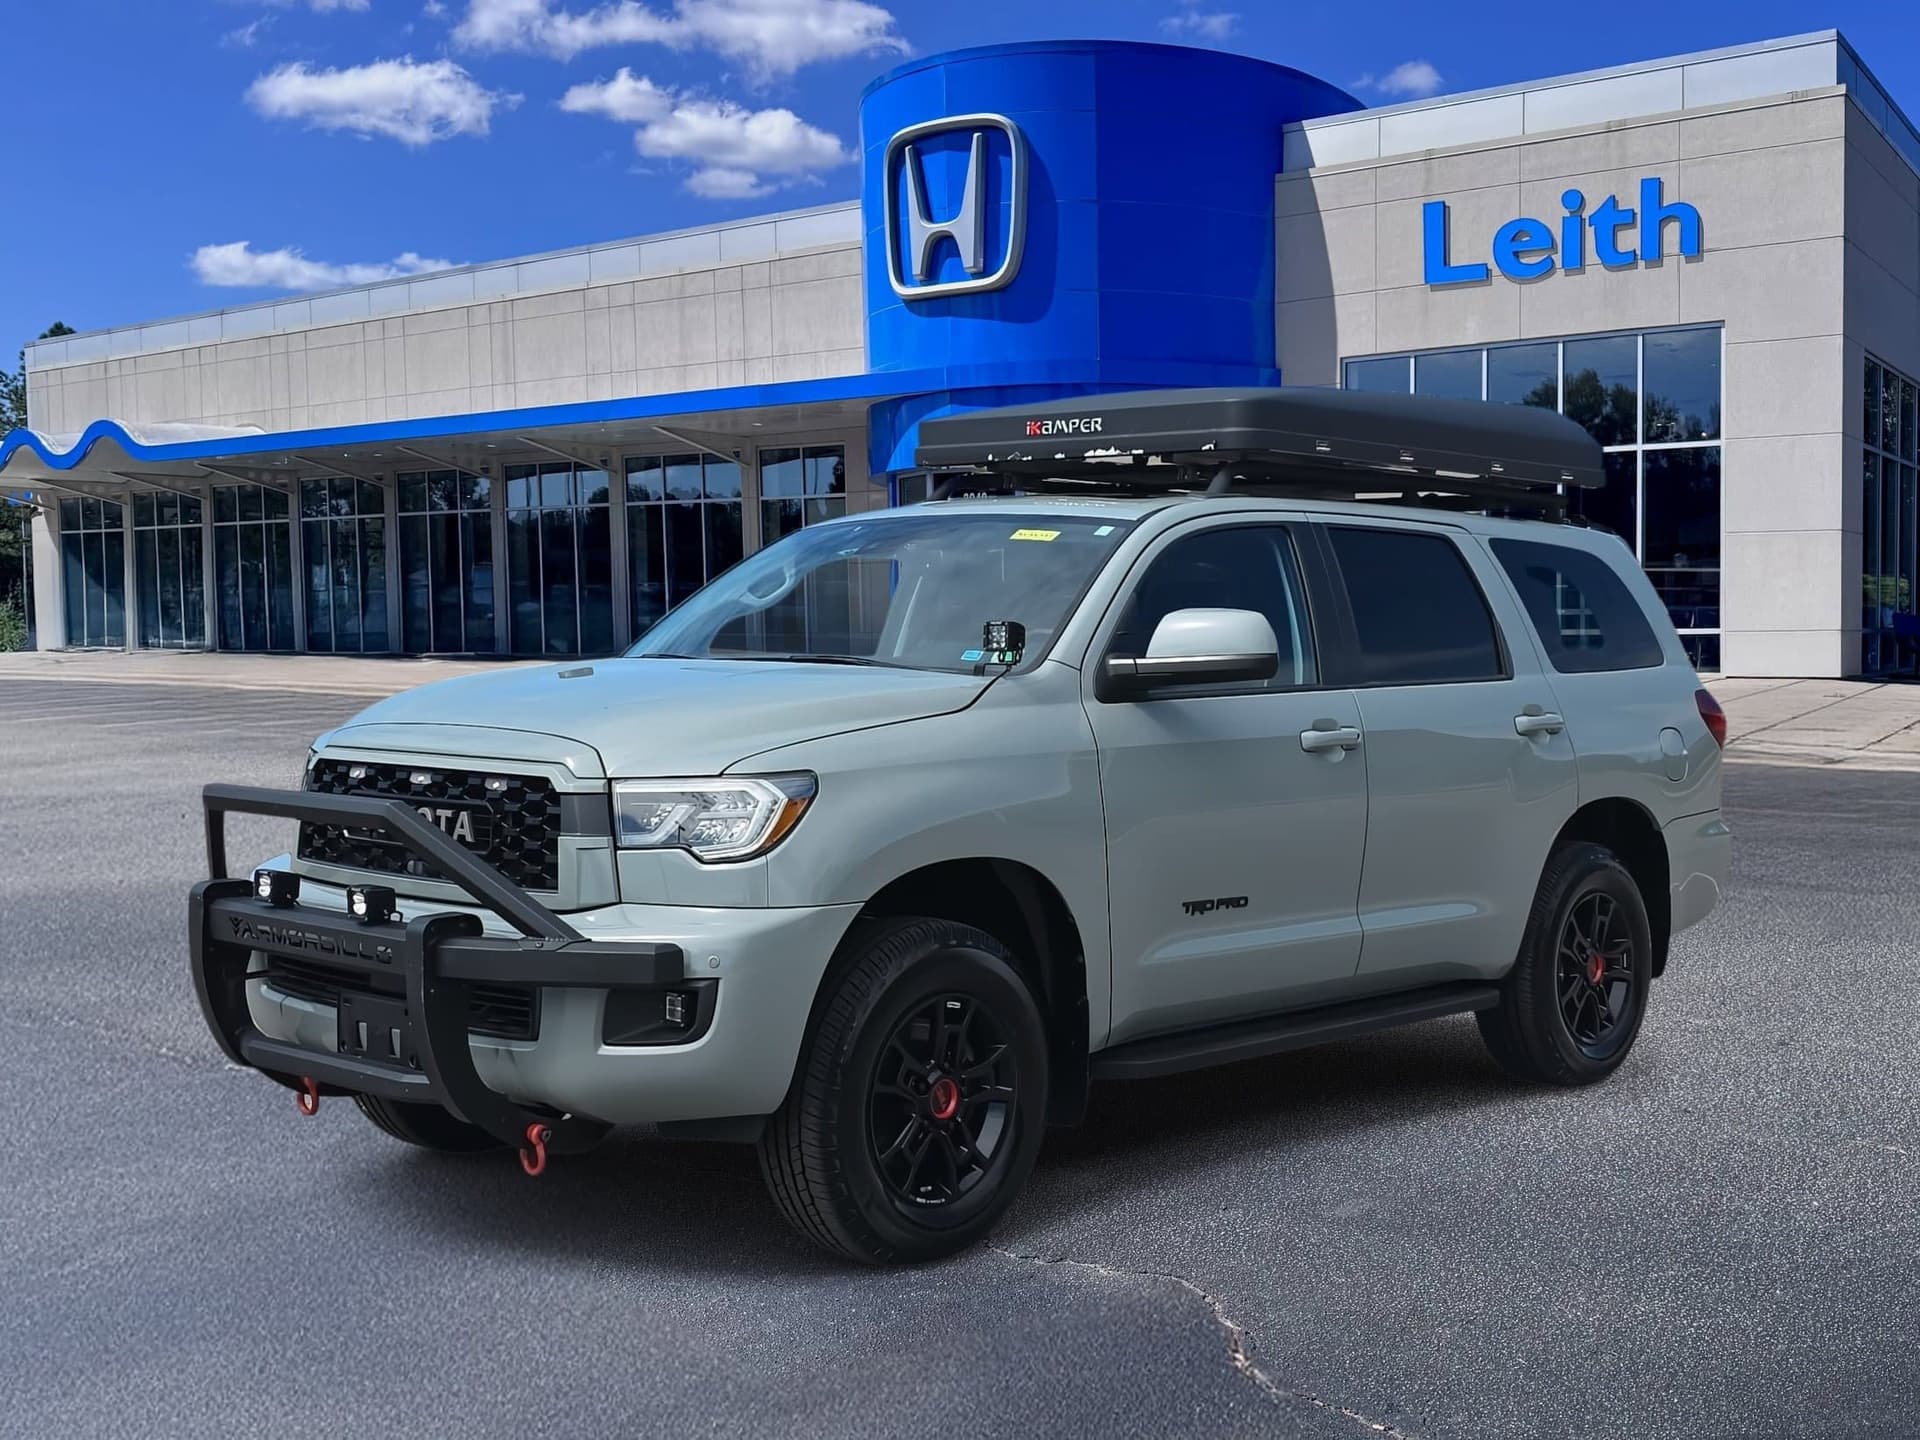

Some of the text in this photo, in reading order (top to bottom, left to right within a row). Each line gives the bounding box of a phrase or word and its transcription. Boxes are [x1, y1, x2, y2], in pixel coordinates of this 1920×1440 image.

[1423, 177, 1700, 286] Leith
[1182, 896, 1249, 916] TRD PRO
